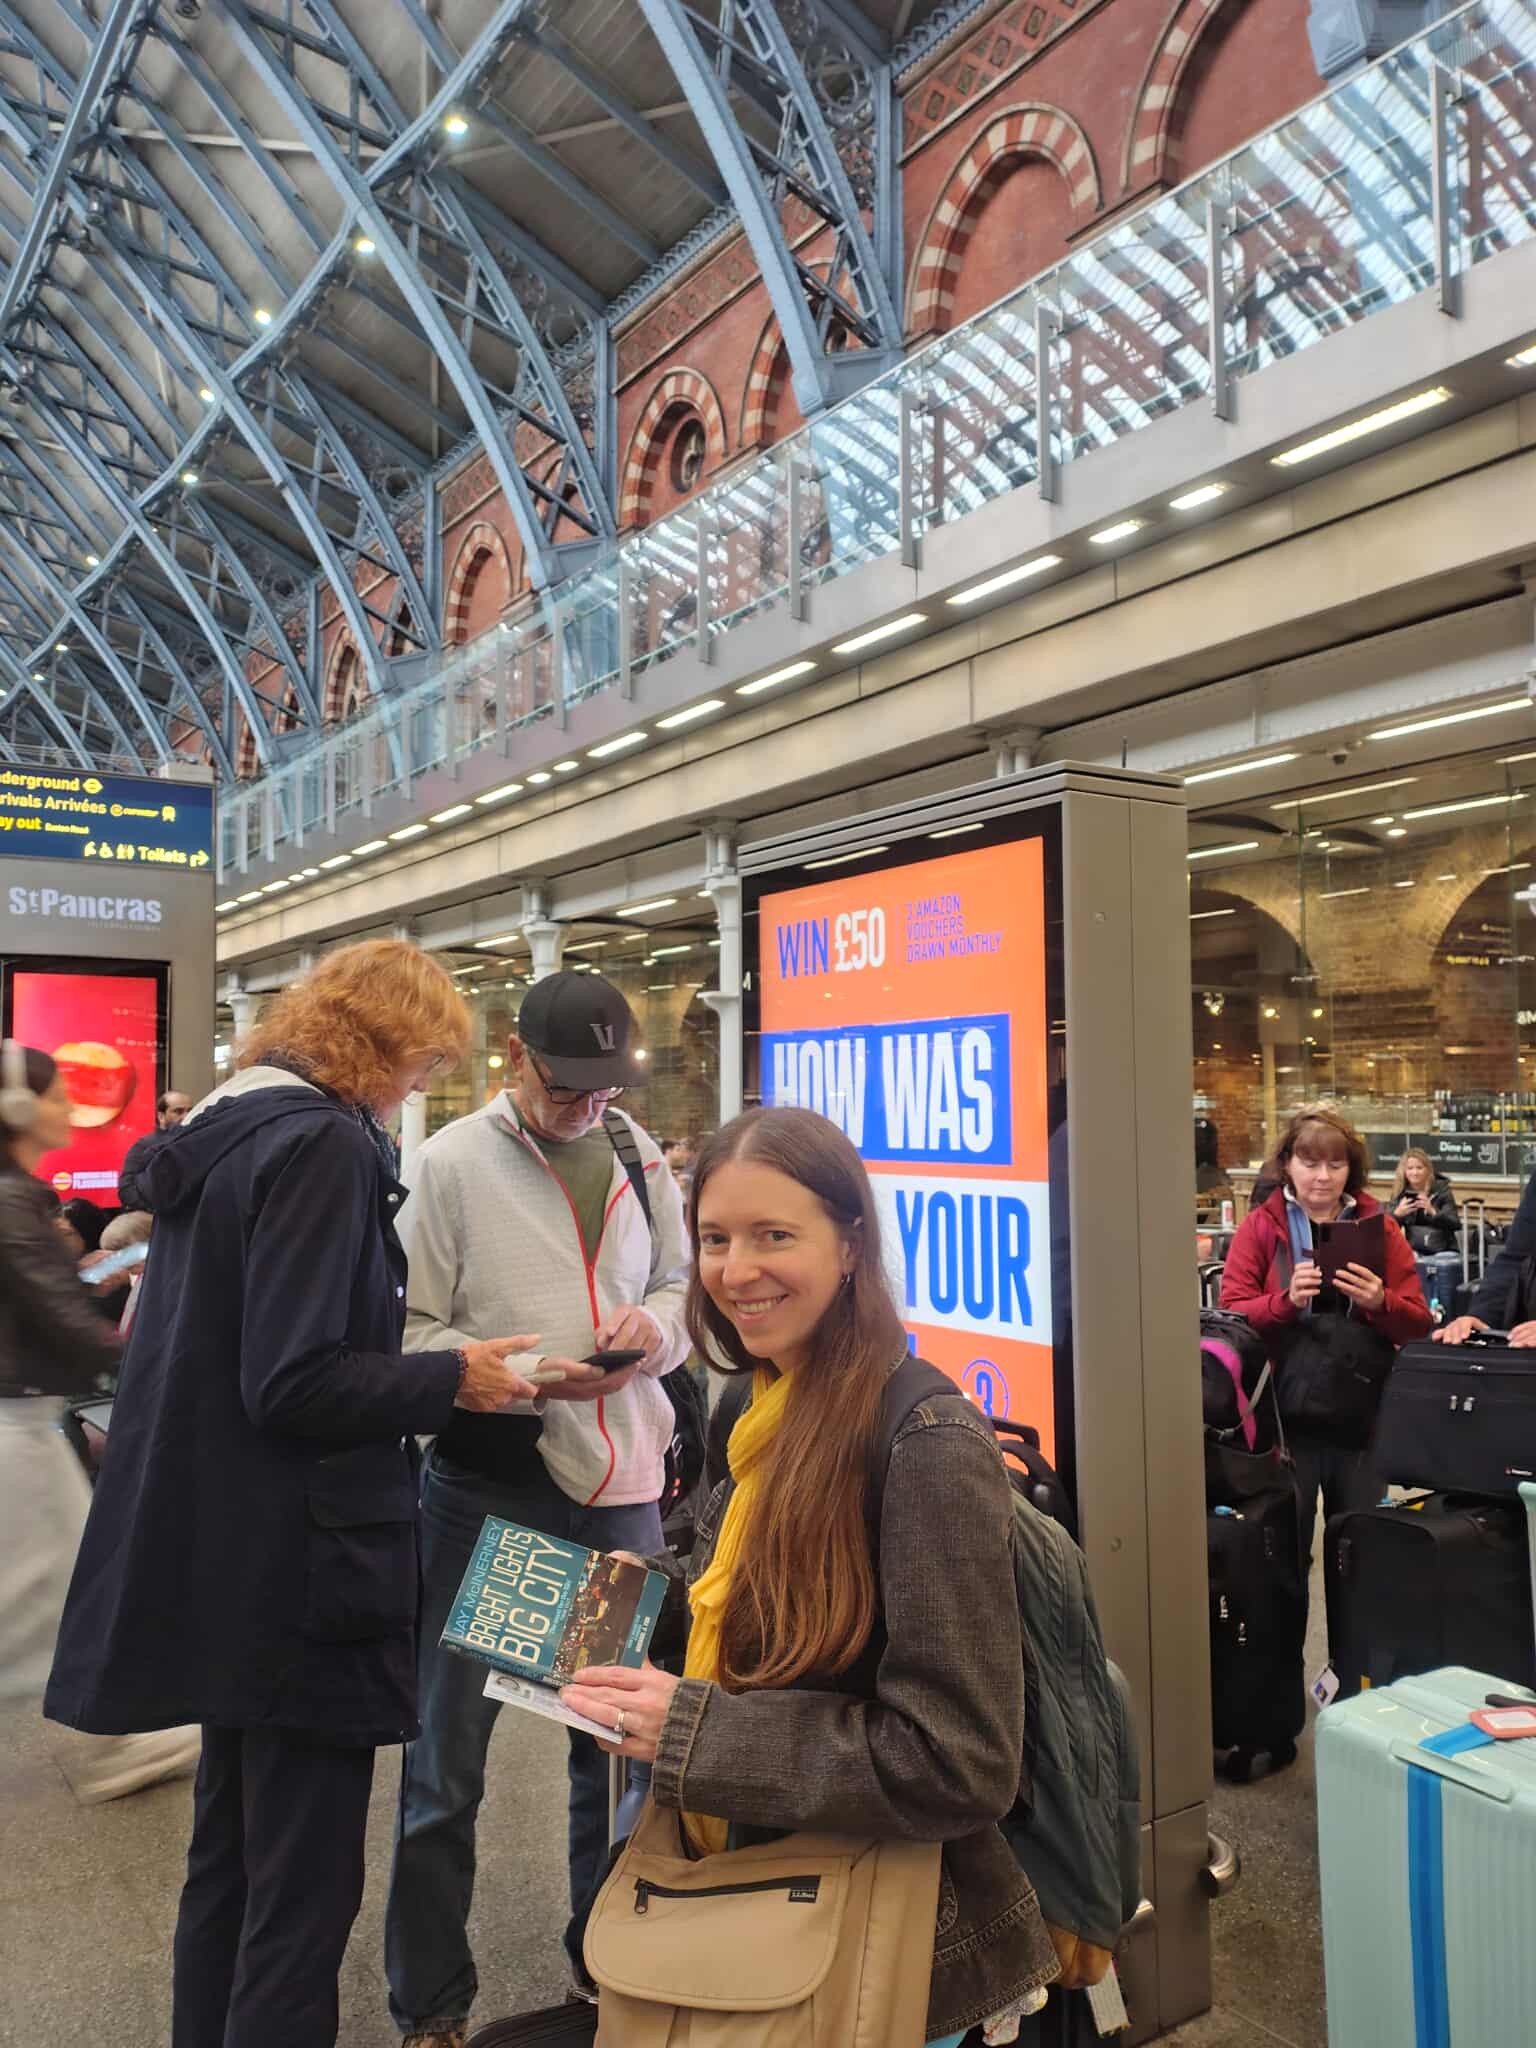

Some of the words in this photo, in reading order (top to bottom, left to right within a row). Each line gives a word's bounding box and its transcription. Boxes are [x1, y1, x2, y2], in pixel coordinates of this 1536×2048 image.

[0, 770, 80, 791] derground
[44, 795, 107, 814] Arrivées
[16, 817, 42, 831] out
[137, 845, 187, 864] Toilets
[916, 894, 961, 918] AMAZON
[834, 907, 885, 972] £50
[906, 914, 964, 942] VOUCHERS
[906, 941, 945, 963] DRAWN
[949, 931, 1002, 957] MONTHLY
[882, 1028, 993, 1153] WAS
[896, 1189, 1033, 1327] YOUR
[519, 1535, 574, 1606] CITY
[454, 1608, 470, 1637] JAY
[465, 1584, 512, 1649] BRIGHT
[497, 1607, 551, 1664] BIG
